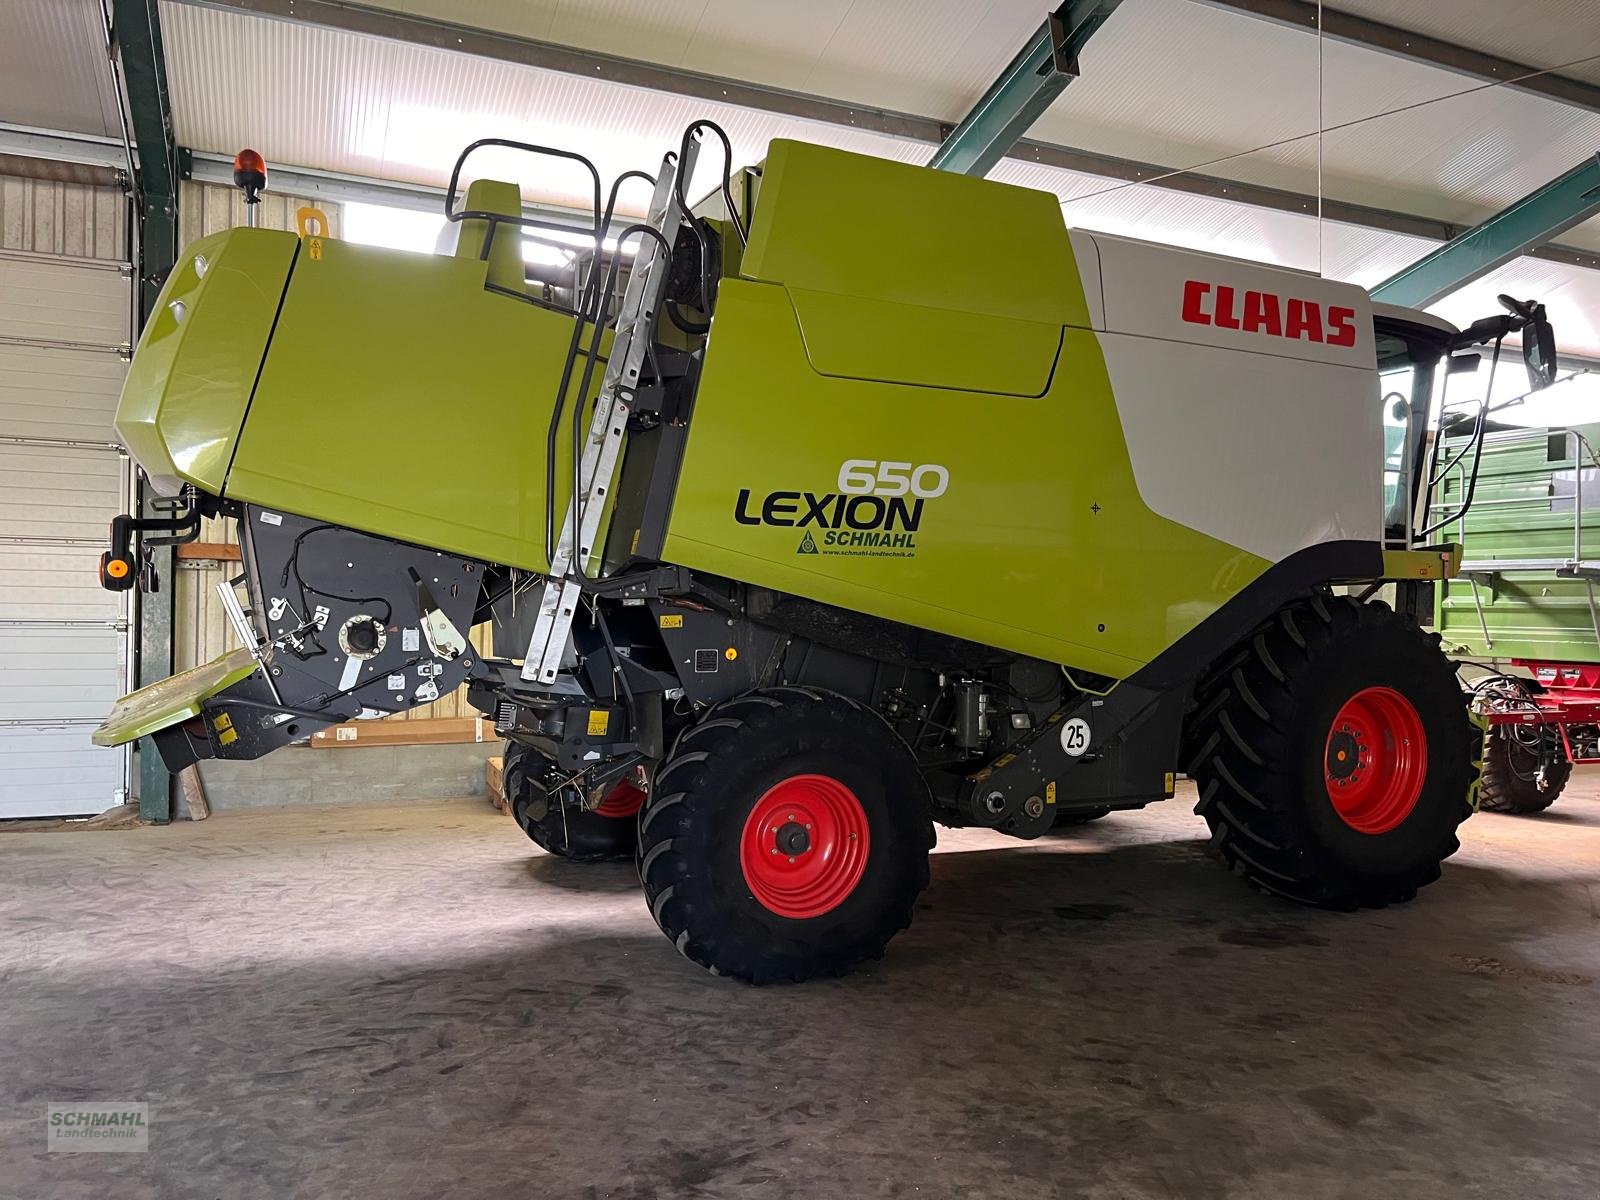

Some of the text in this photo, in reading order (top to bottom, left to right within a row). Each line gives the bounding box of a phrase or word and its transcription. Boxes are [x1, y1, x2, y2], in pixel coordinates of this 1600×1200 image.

[1182, 280, 1355, 347] CLAAS
[838, 459, 949, 498] 650
[735, 489, 924, 531] LEXION
[822, 549, 915, 557] www.schmahl-landtechnik.de
[824, 530, 916, 548] SCHMAHL
[1067, 725, 1084, 748] 25
